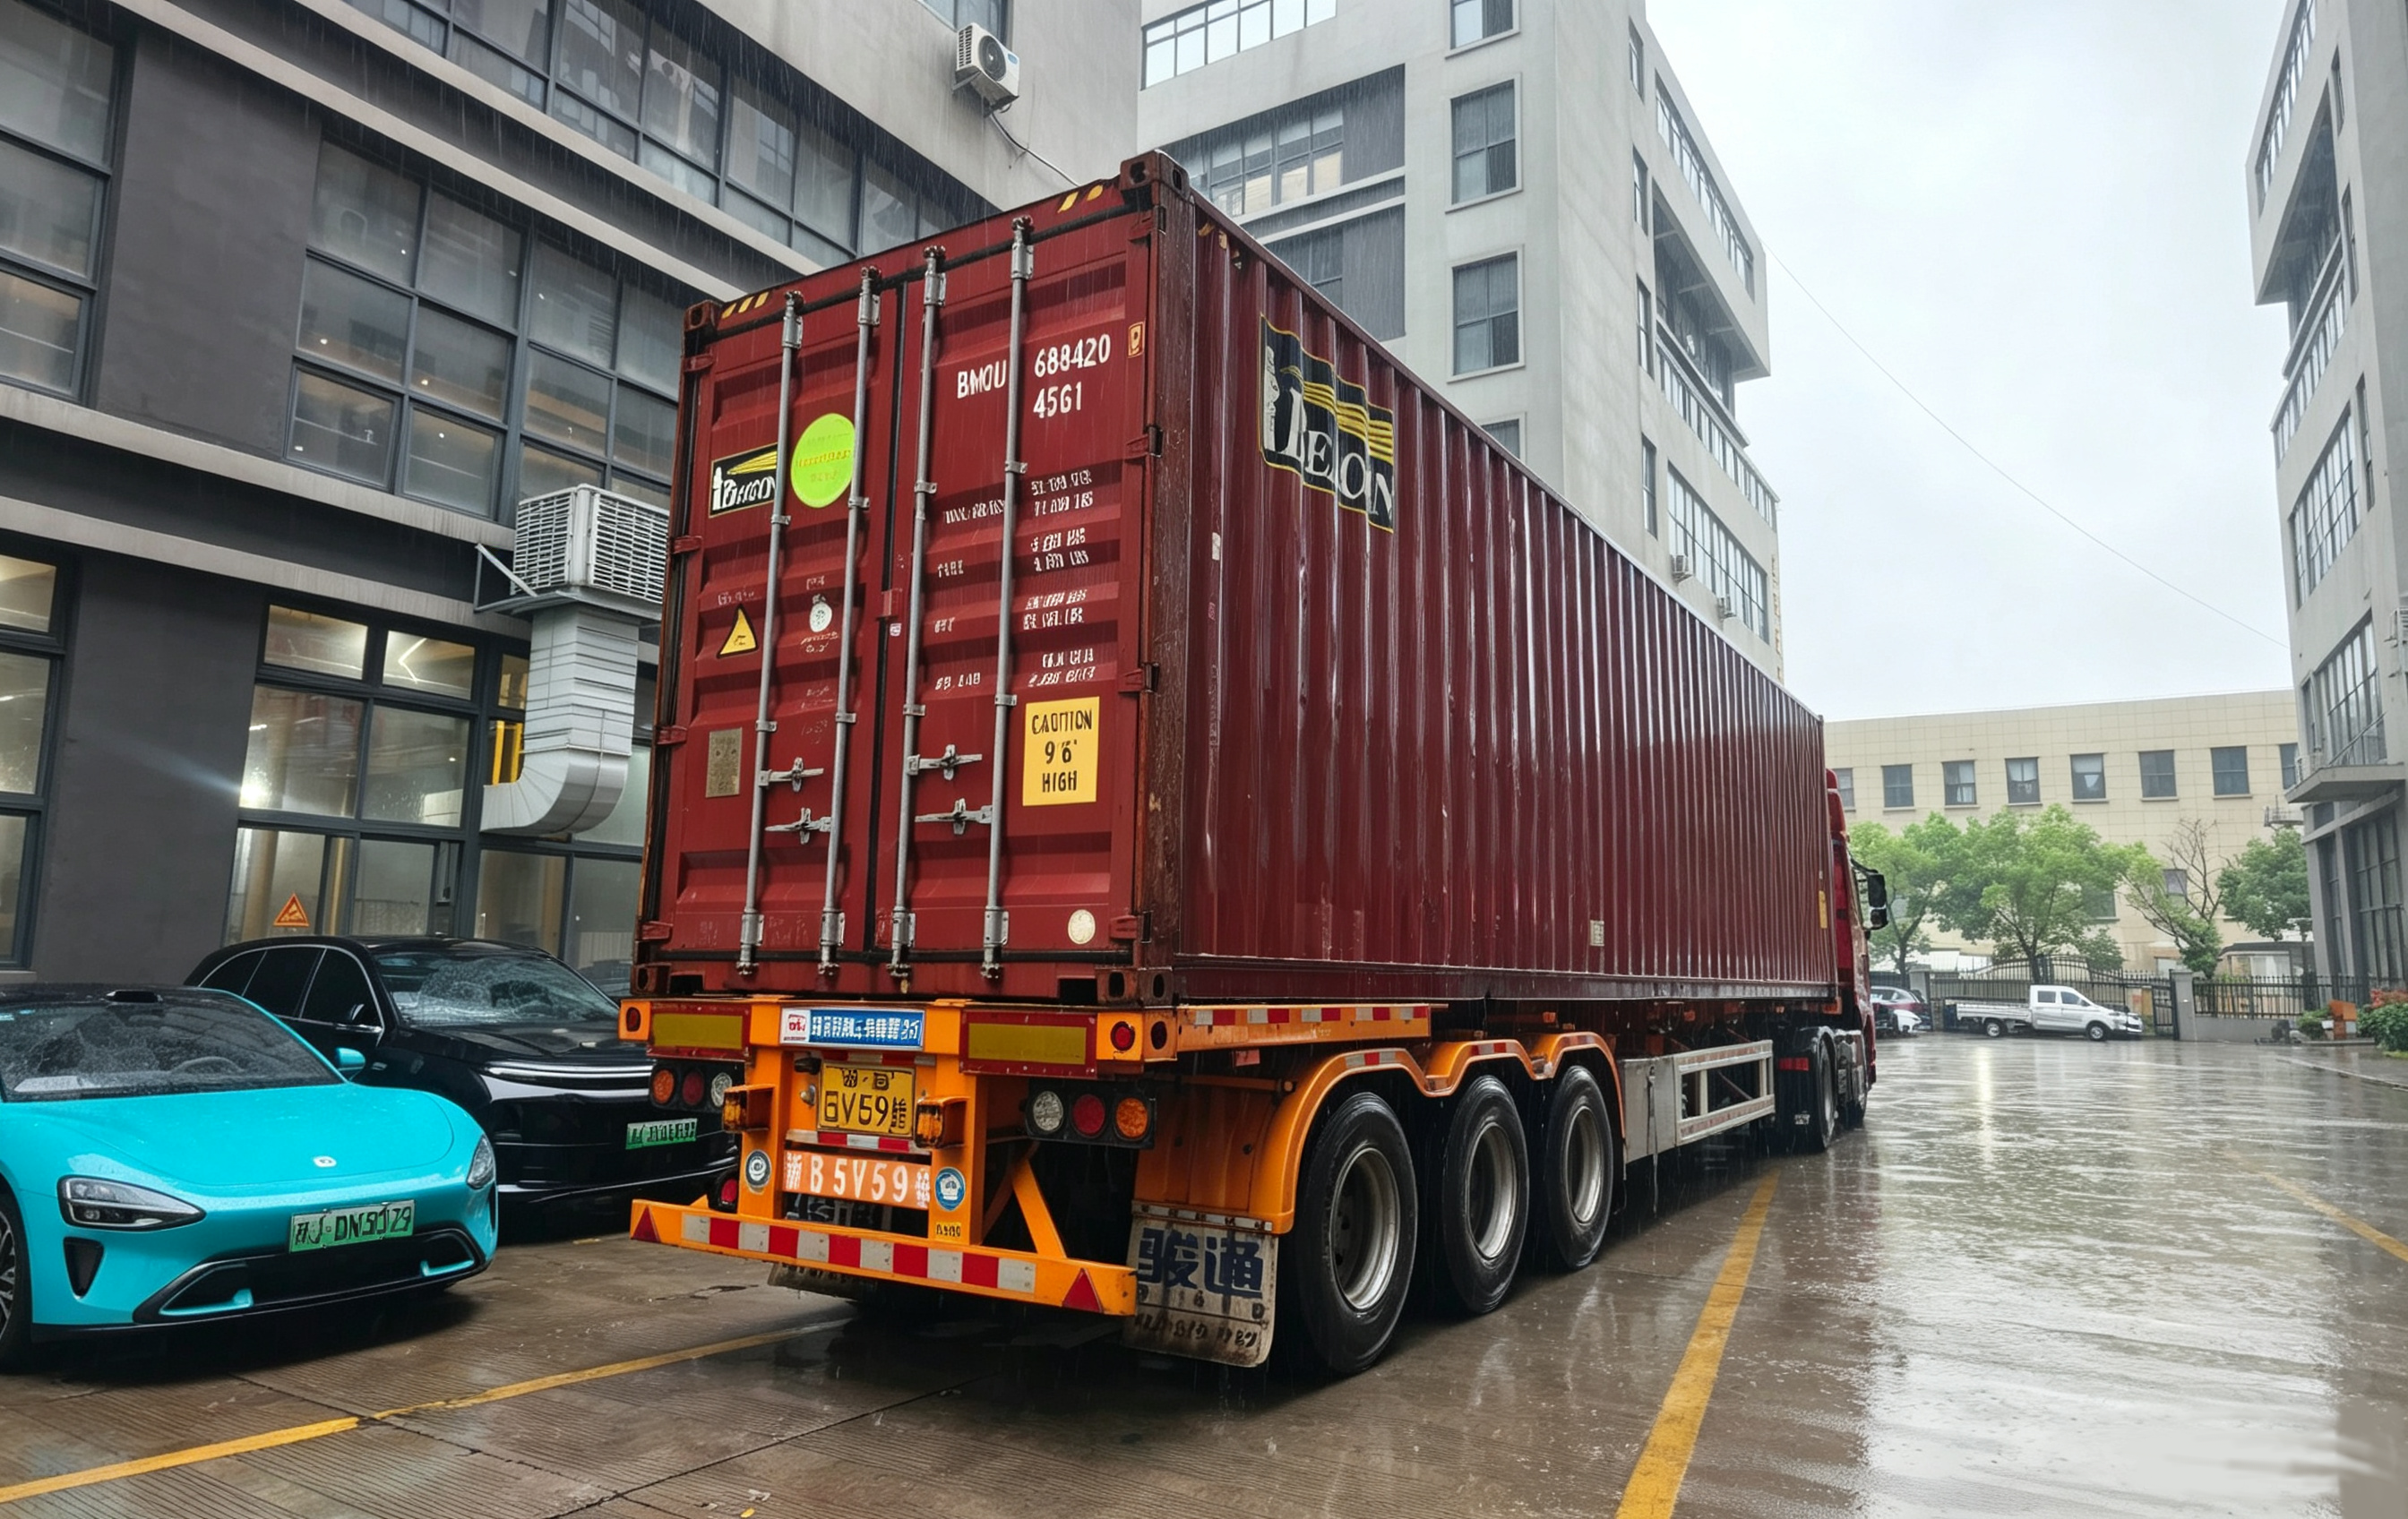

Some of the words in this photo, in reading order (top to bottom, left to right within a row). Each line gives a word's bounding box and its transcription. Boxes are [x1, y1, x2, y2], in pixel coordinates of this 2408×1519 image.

[957, 359, 1007, 399] BMOU
[1034, 333, 1111, 378] 688420
[1033, 381, 1082, 419] 45G1
[1042, 770, 1078, 794] HIGH
